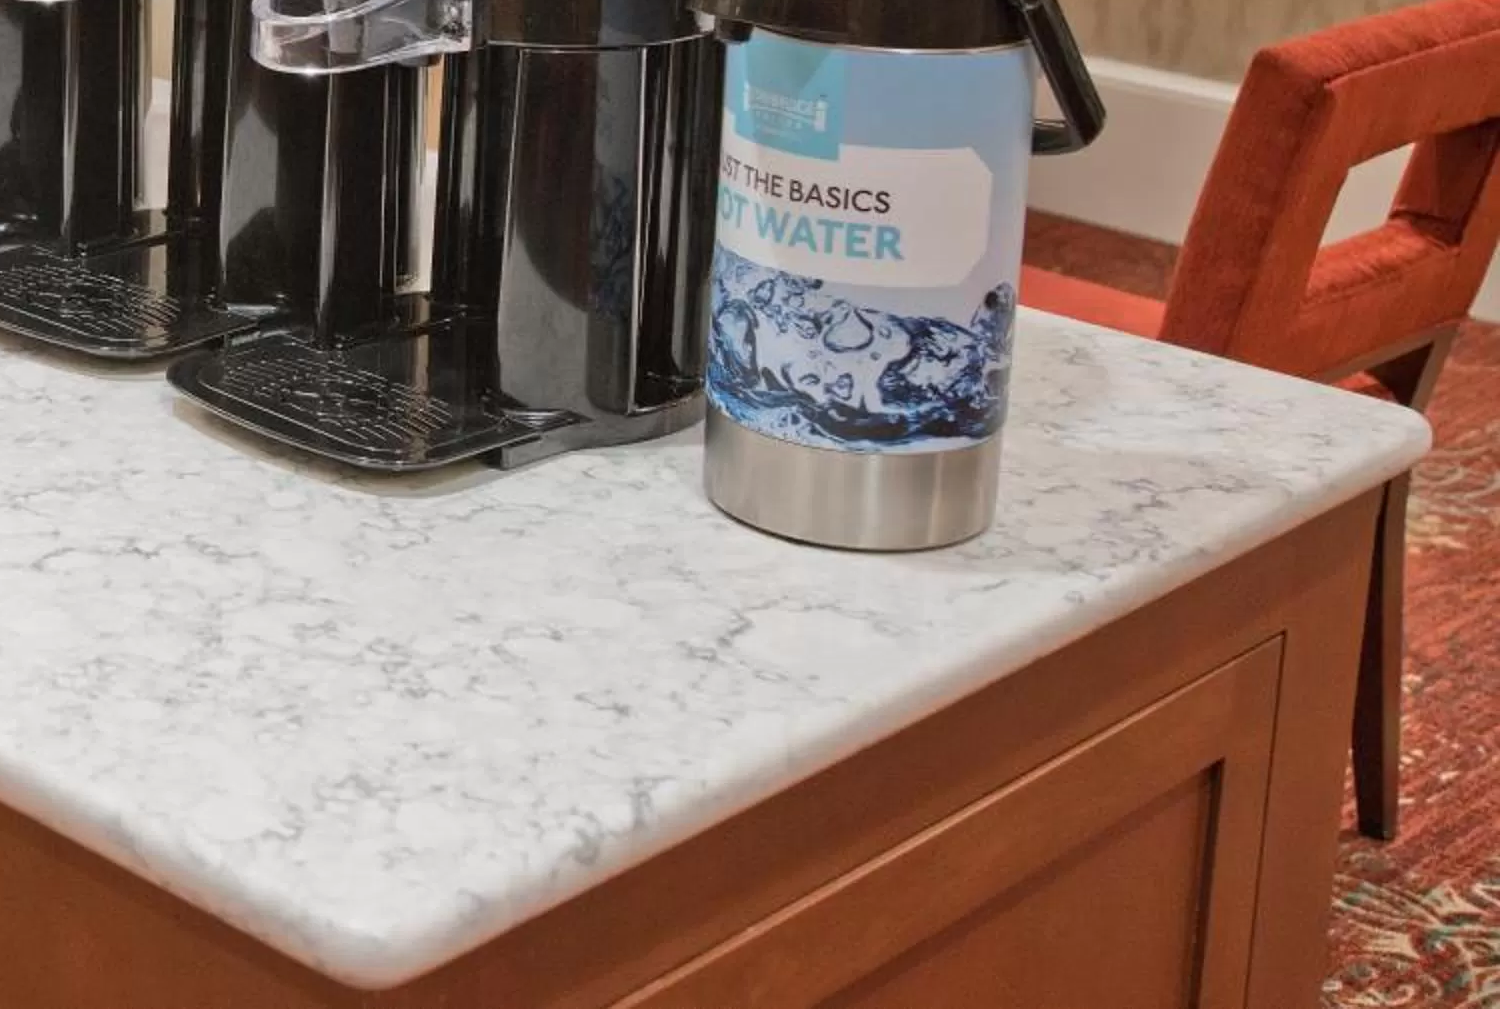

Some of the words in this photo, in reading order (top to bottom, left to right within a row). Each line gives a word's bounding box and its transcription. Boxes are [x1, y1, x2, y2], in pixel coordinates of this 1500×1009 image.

[744, 164, 784, 199] THE
[789, 179, 891, 214] BASICS
[755, 202, 904, 260] WATER
